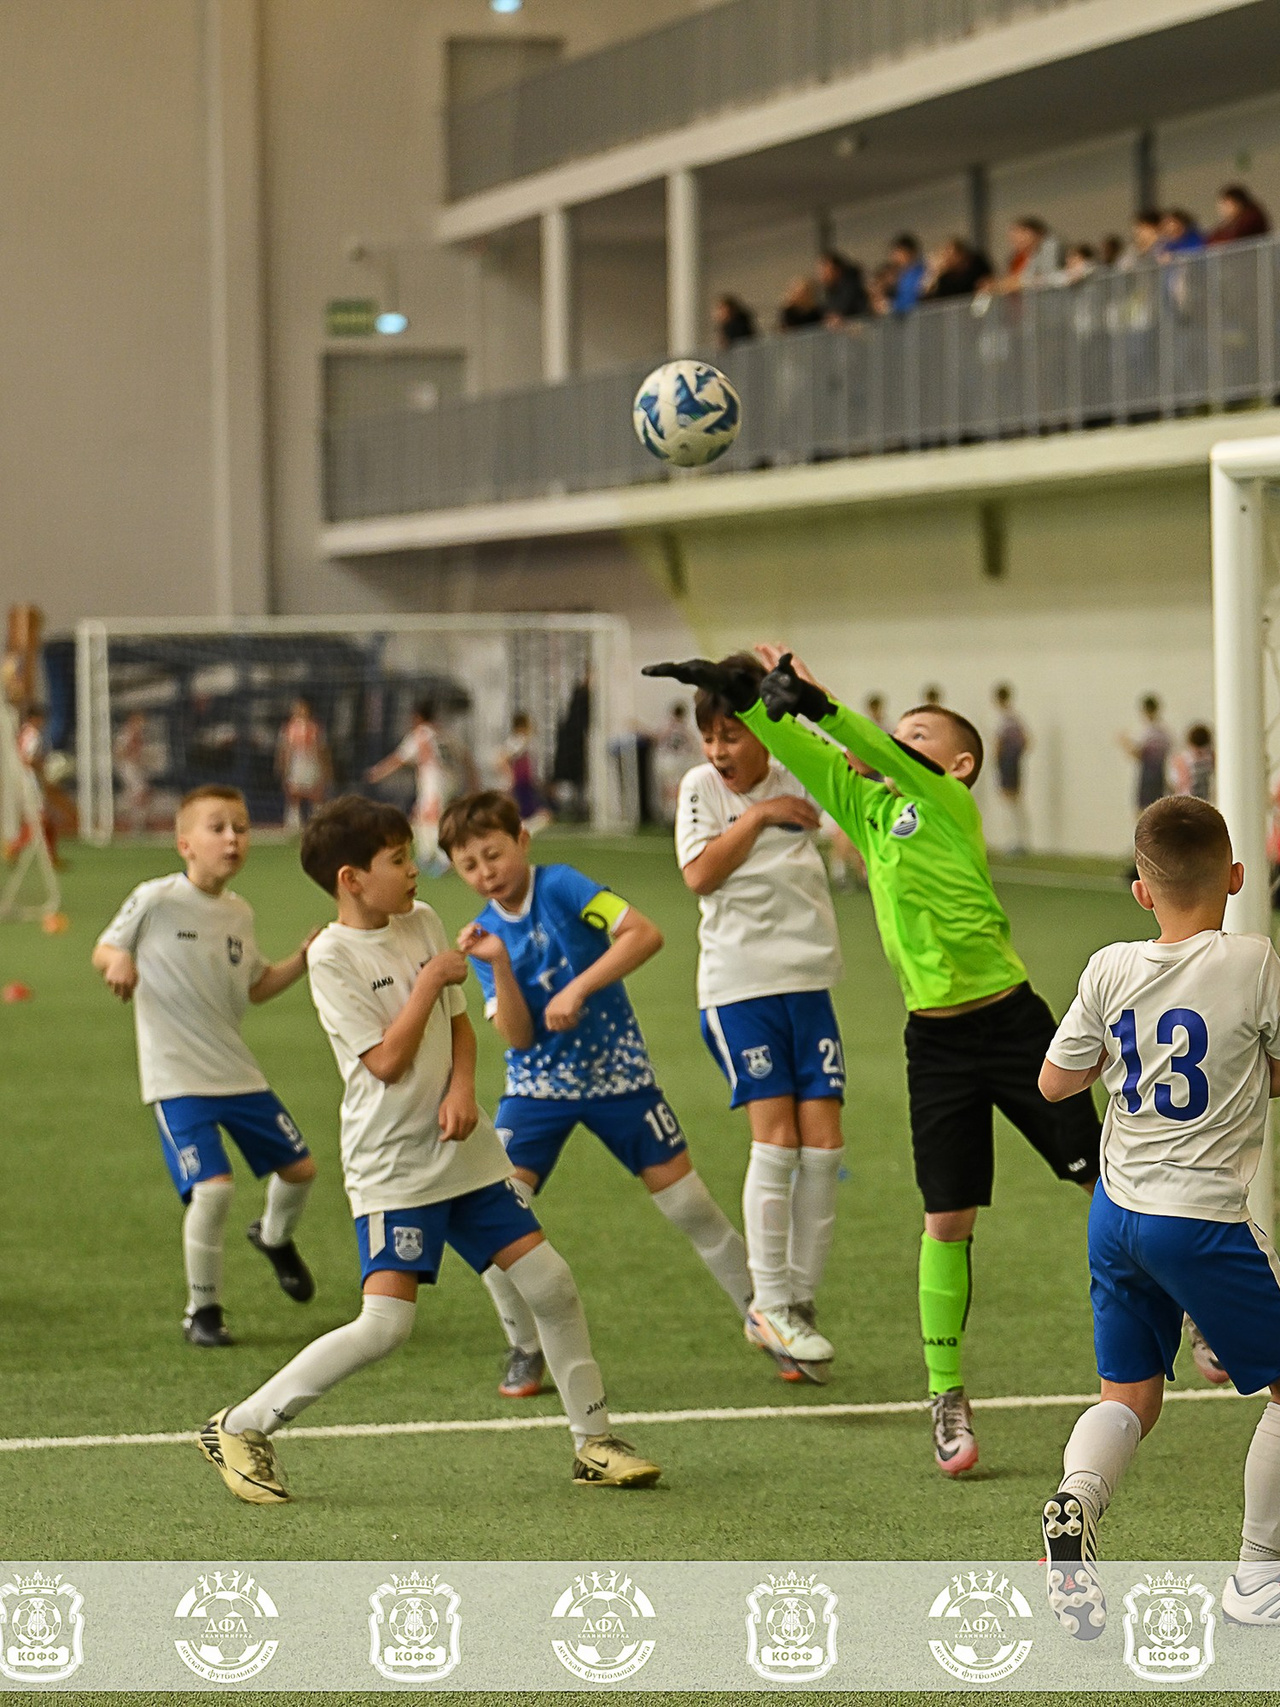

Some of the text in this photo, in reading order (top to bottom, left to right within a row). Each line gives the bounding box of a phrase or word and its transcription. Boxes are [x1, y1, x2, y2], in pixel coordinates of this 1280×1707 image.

[371, 976, 394, 992] JAKO
[1109, 1007, 1209, 1122] 13
[644, 1101, 677, 1142] 16
